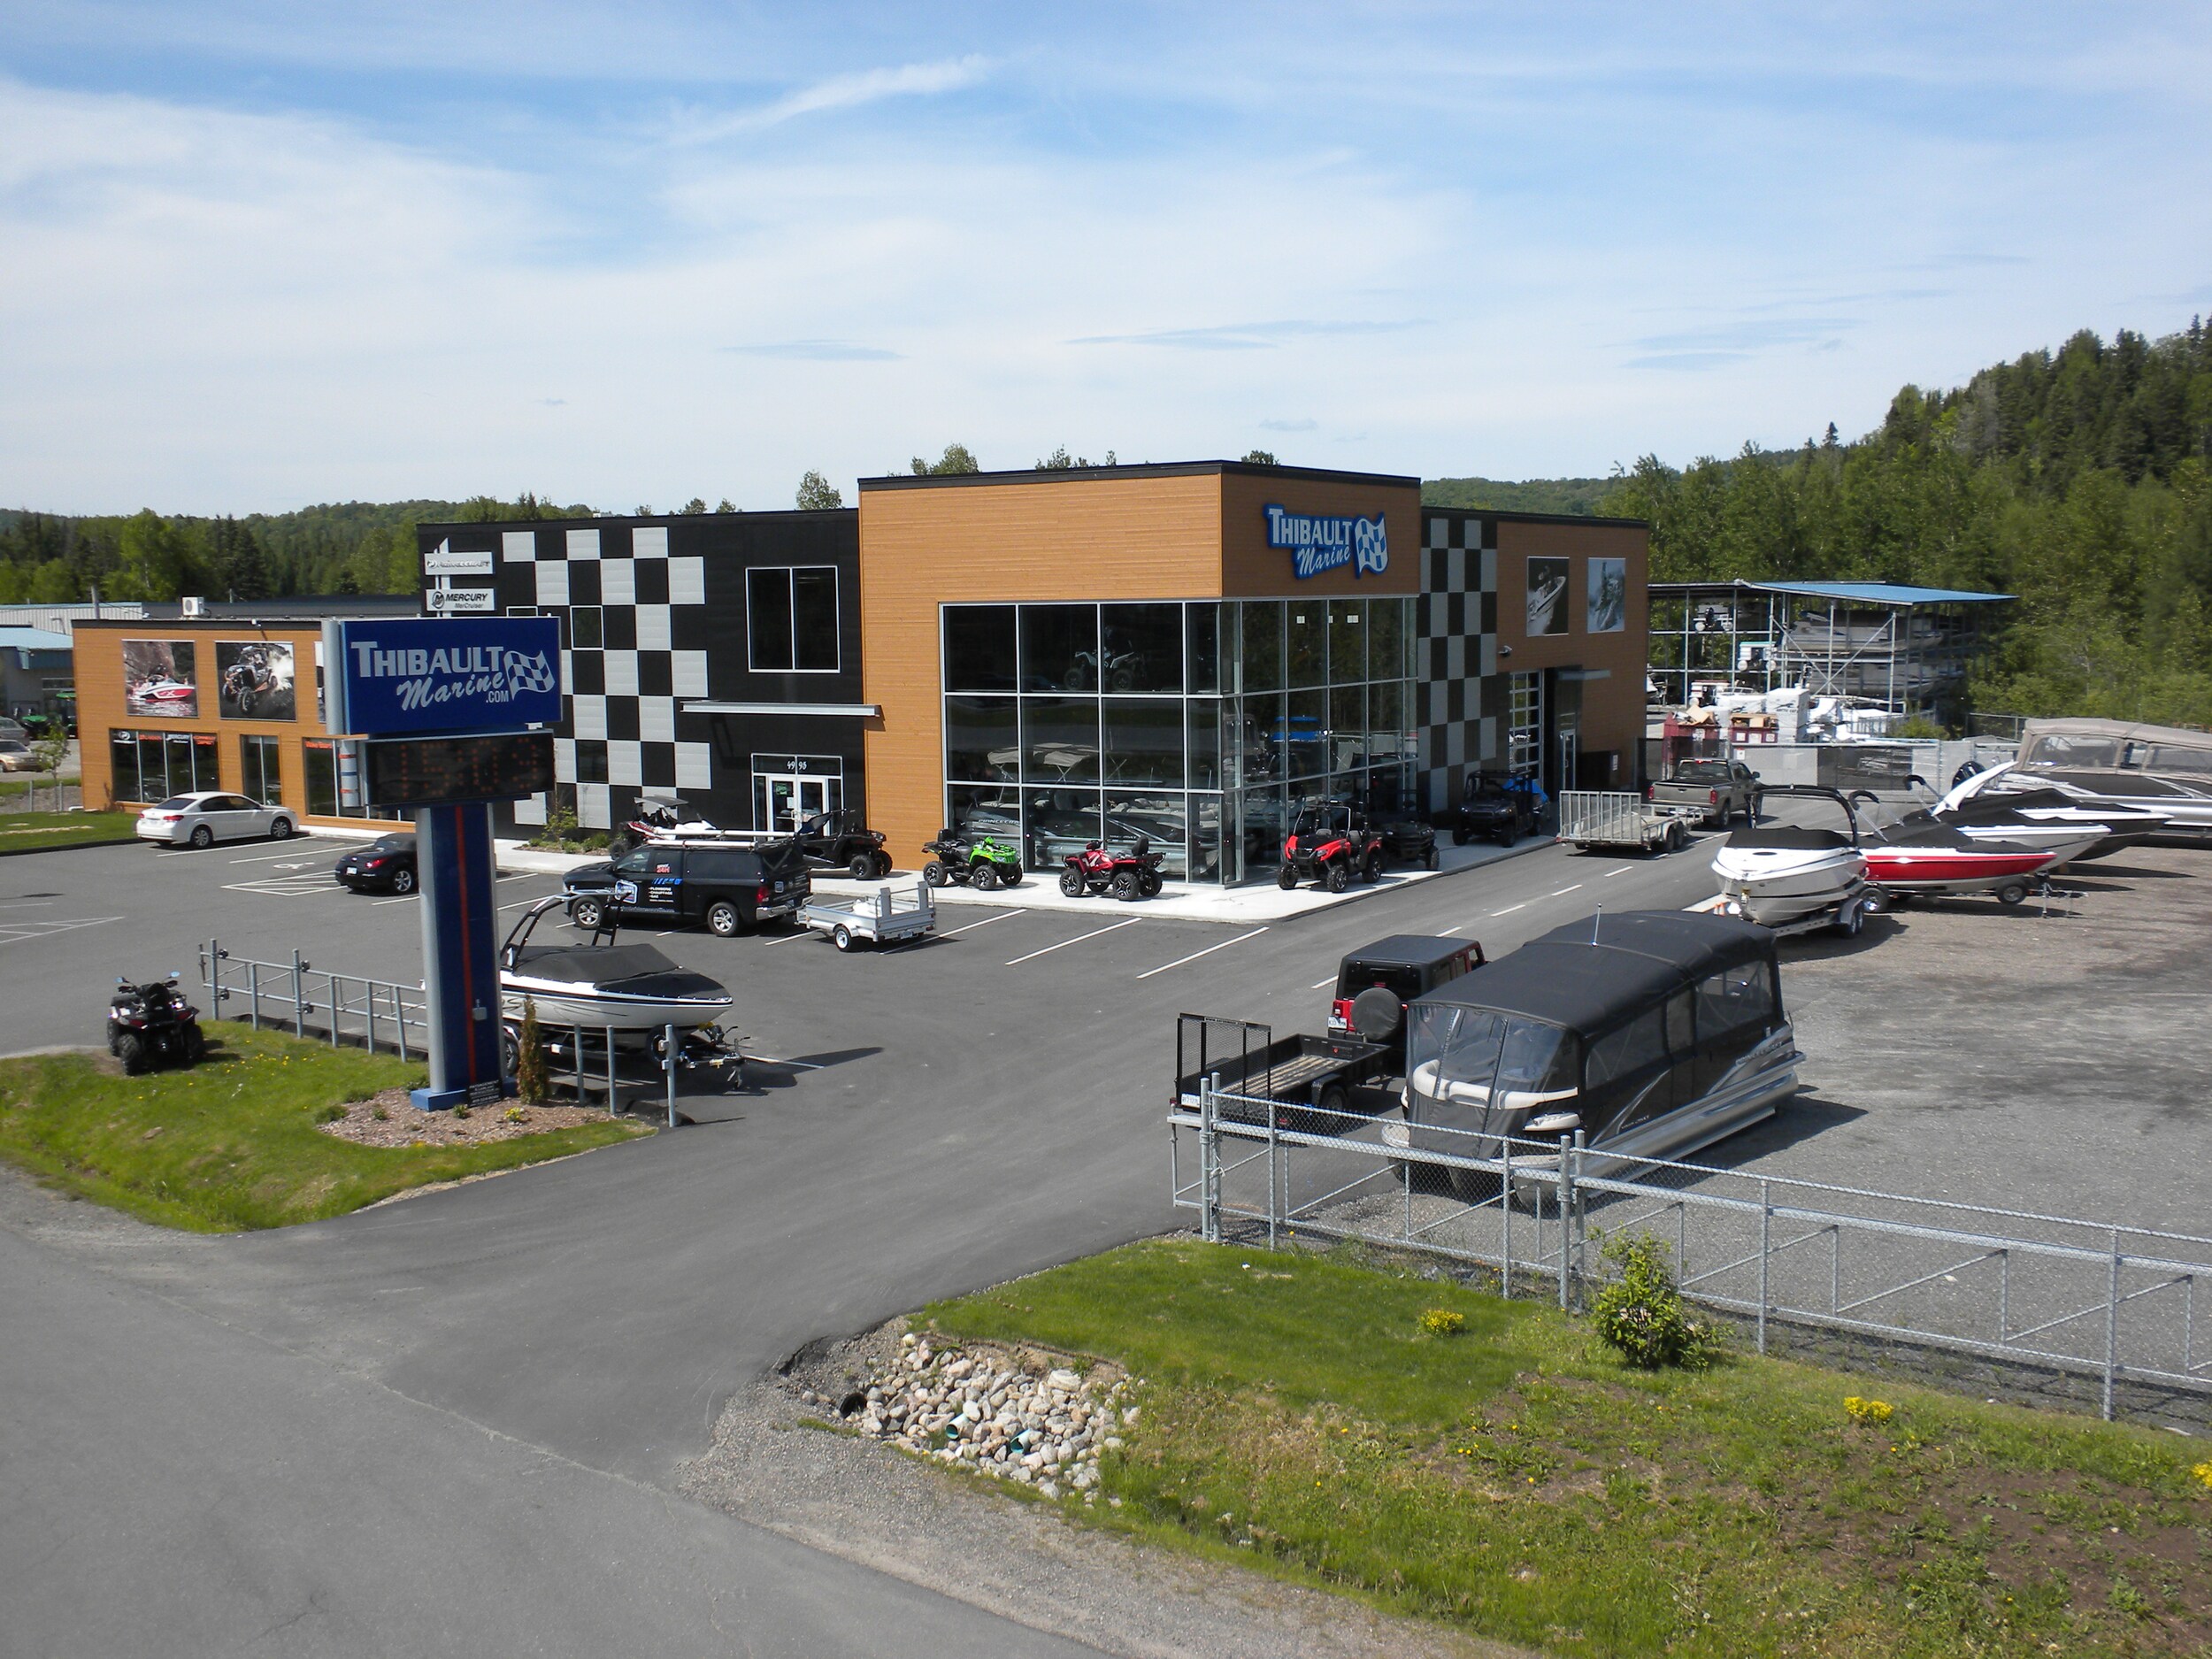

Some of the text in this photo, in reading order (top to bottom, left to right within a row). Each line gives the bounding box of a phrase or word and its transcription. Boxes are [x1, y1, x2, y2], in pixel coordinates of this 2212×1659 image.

[1269, 508, 1352, 546] THIBAULT
[1297, 545, 1351, 575] Marine
[351, 641, 503, 677] THIBAULT
[396, 672, 504, 710] Marine
